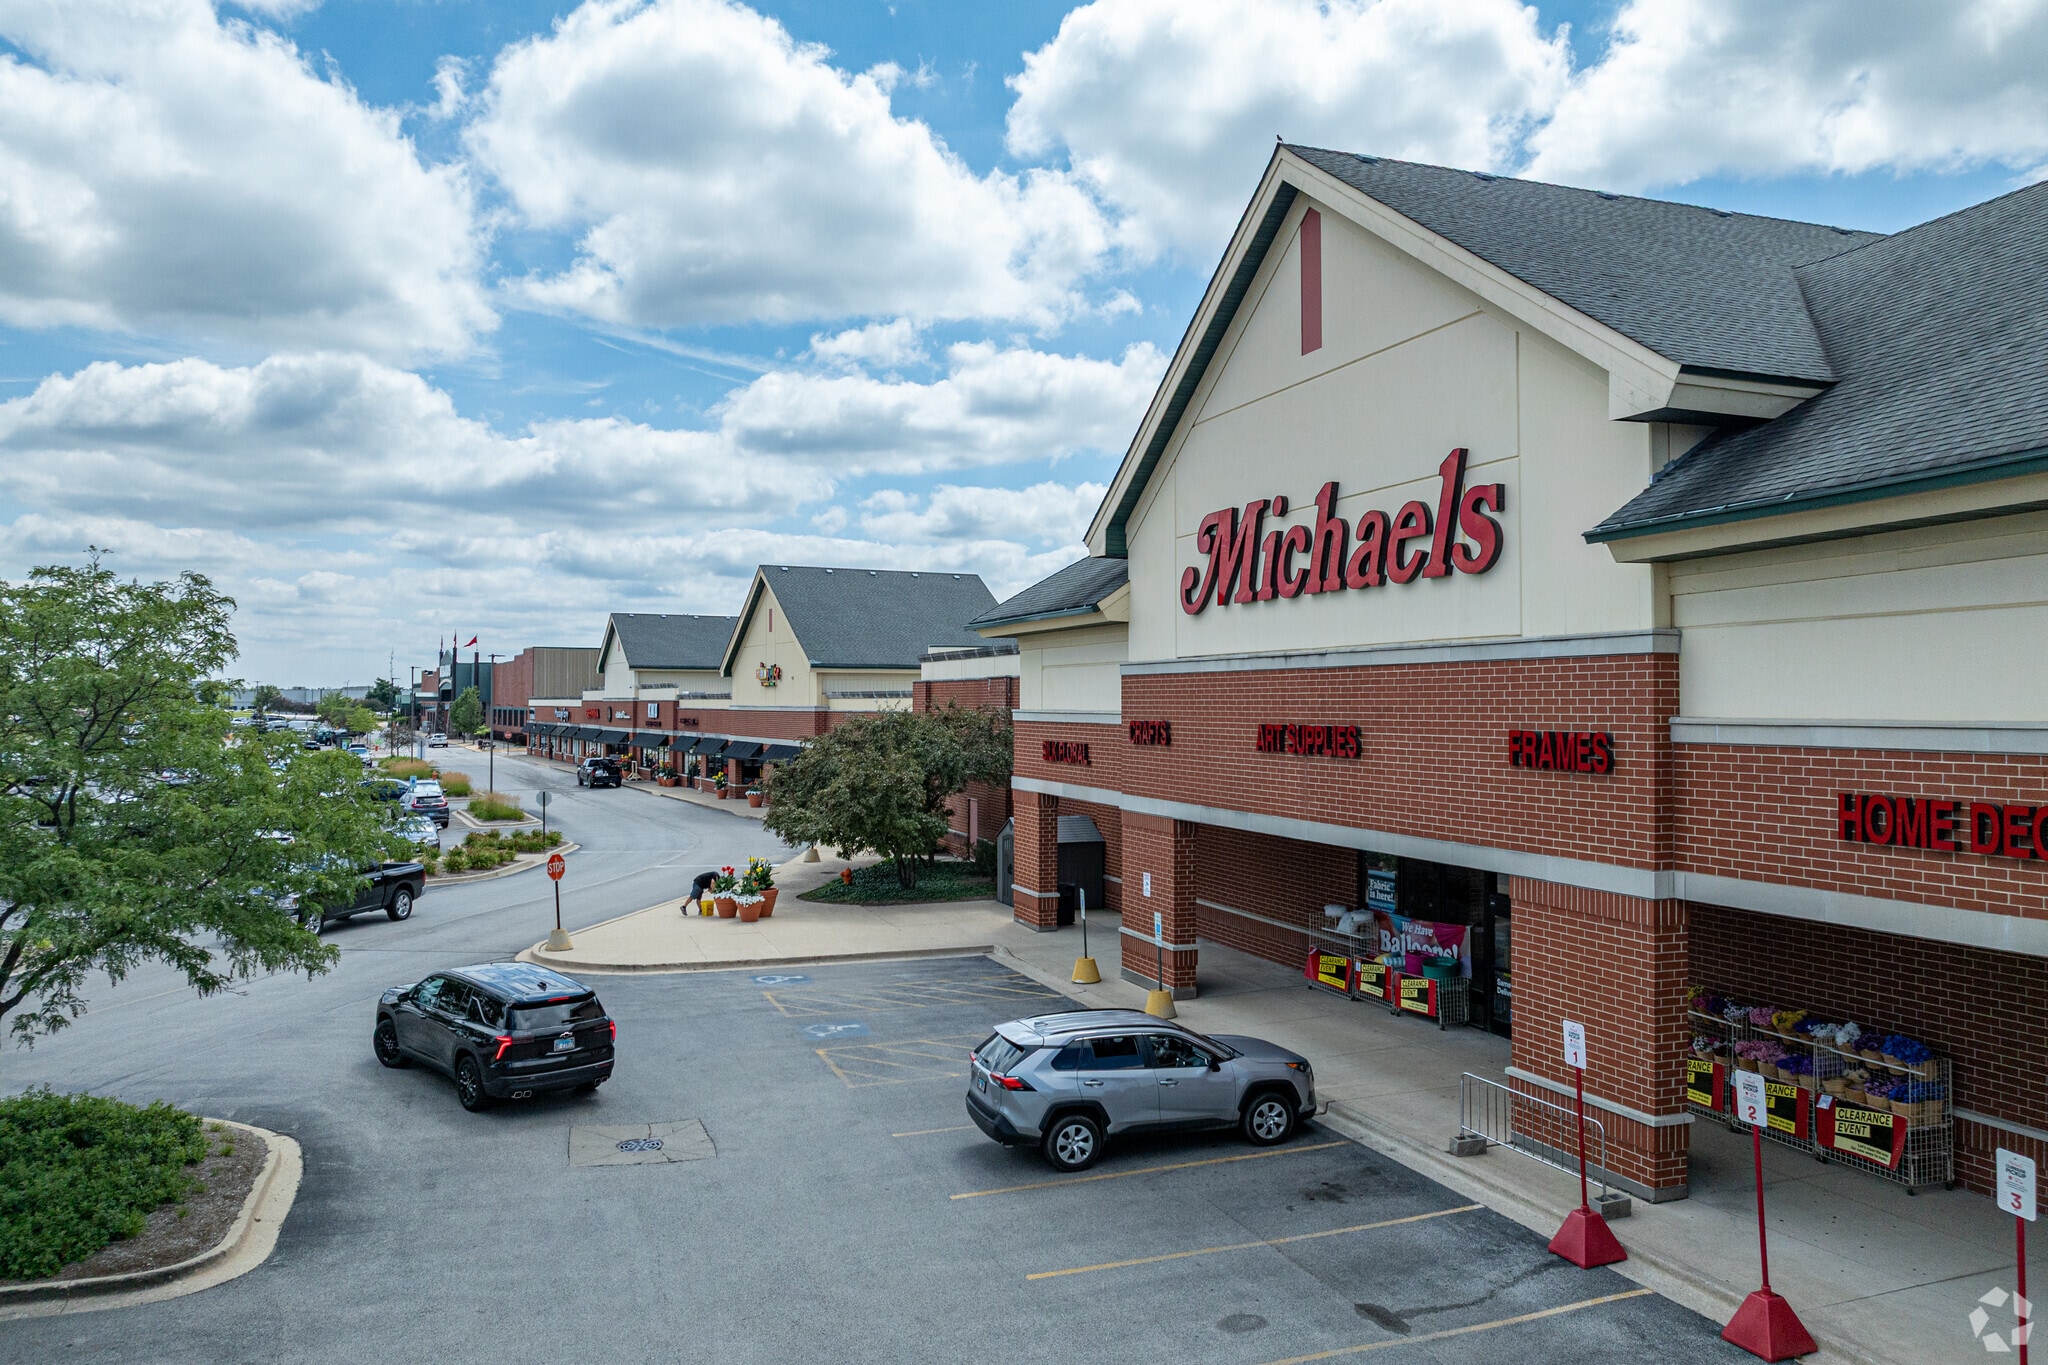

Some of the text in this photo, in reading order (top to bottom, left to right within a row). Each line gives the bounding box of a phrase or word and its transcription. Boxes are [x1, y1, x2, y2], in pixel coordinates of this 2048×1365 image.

[1180, 448, 1505, 615] Michaels
[1129, 720, 1170, 746] CRAFTS
[1255, 723, 1360, 758] ART SUPPLIES
[1058, 741, 1090, 765] FLORAL
[1509, 730, 1613, 774] FRAMES
[1838, 793, 1961, 852] HOME
[548, 861, 564, 874] STOP
[1369, 879, 1391, 892] Fabric
[1369, 888, 1376, 898] is
[1401, 921, 1434, 937] We Have
[1320, 956, 1345, 966] CLEARANCE
[1320, 964, 1335, 973] EVENT
[1362, 964, 1385, 973] CLEARANCE
[1362, 973, 1375, 981] EVENT
[1402, 979, 1428, 988] CLEARANCE
[1402, 989, 1416, 997] EVENT
[1573, 1051, 1578, 1063] 1
[1687, 1060, 1712, 1072] RANCE
[1766, 1084, 1795, 1097] RANCE
[1747, 1105, 1757, 1120] 2
[1837, 1108, 1891, 1126] CLEARANCE
[1837, 1122, 1867, 1135] EVENT
[2010, 1191, 2022, 1210] 3
